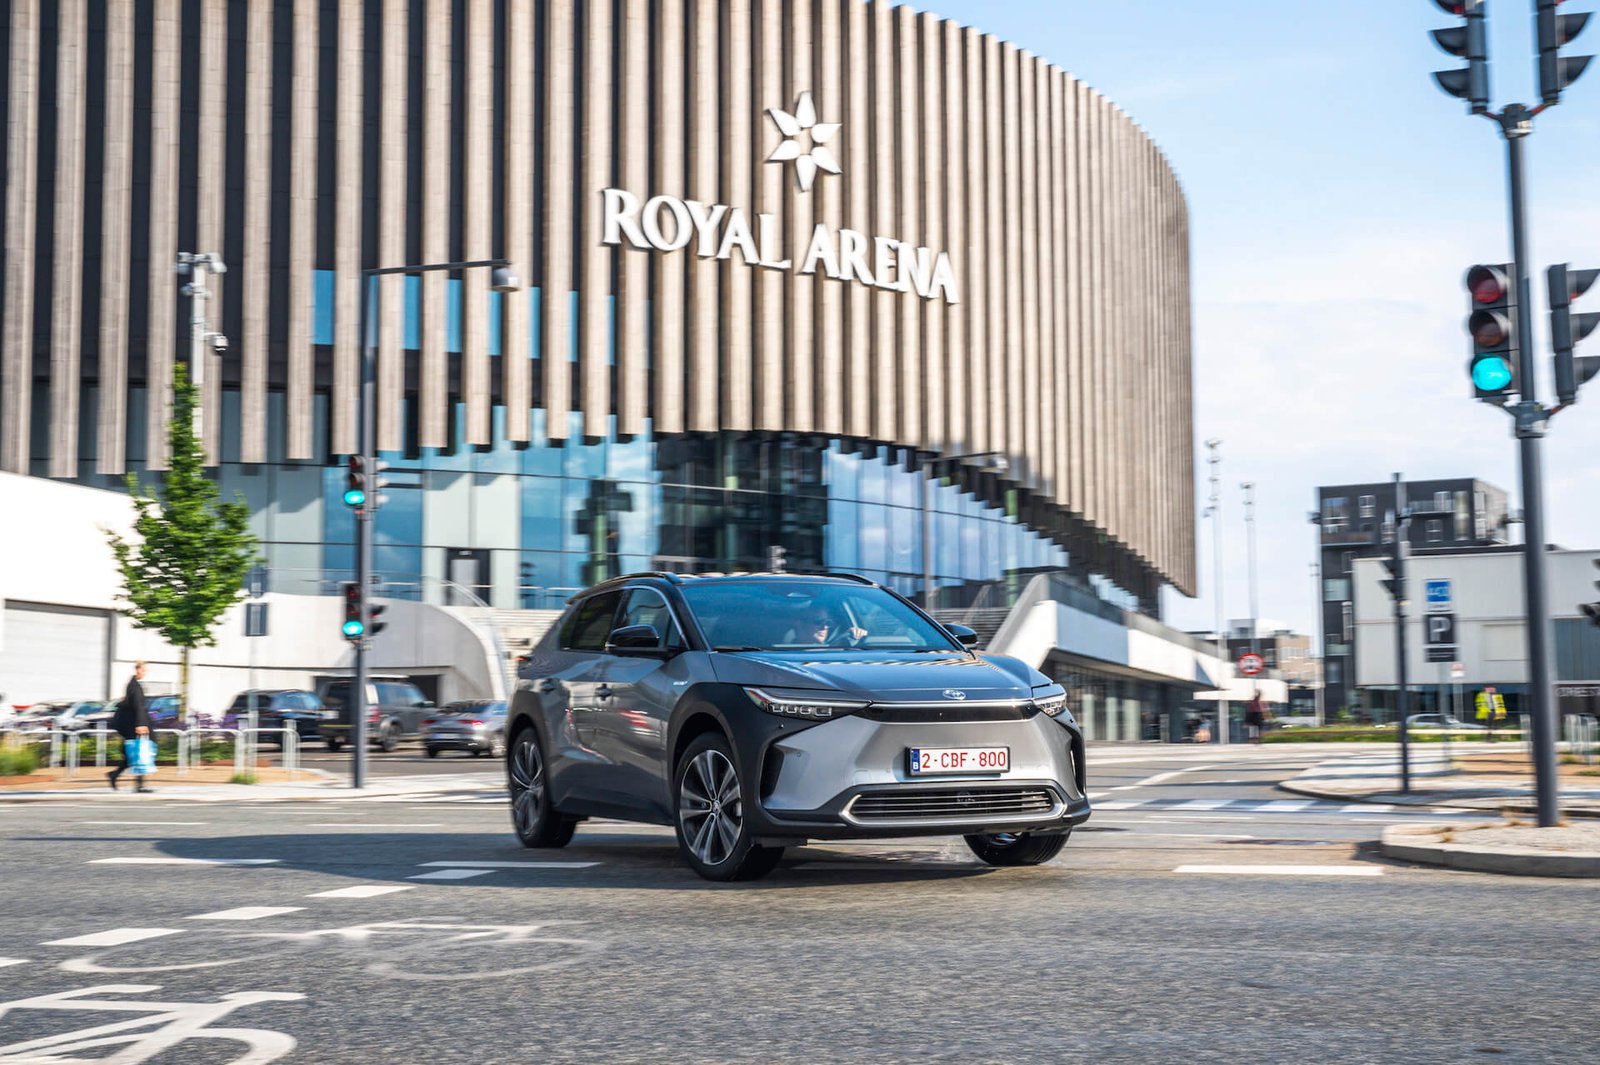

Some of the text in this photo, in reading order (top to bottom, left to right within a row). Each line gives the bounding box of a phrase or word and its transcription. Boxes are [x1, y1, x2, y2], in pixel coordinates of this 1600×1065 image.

[602, 187, 961, 304] ROYAL ARENA
[1429, 616, 1451, 642] P
